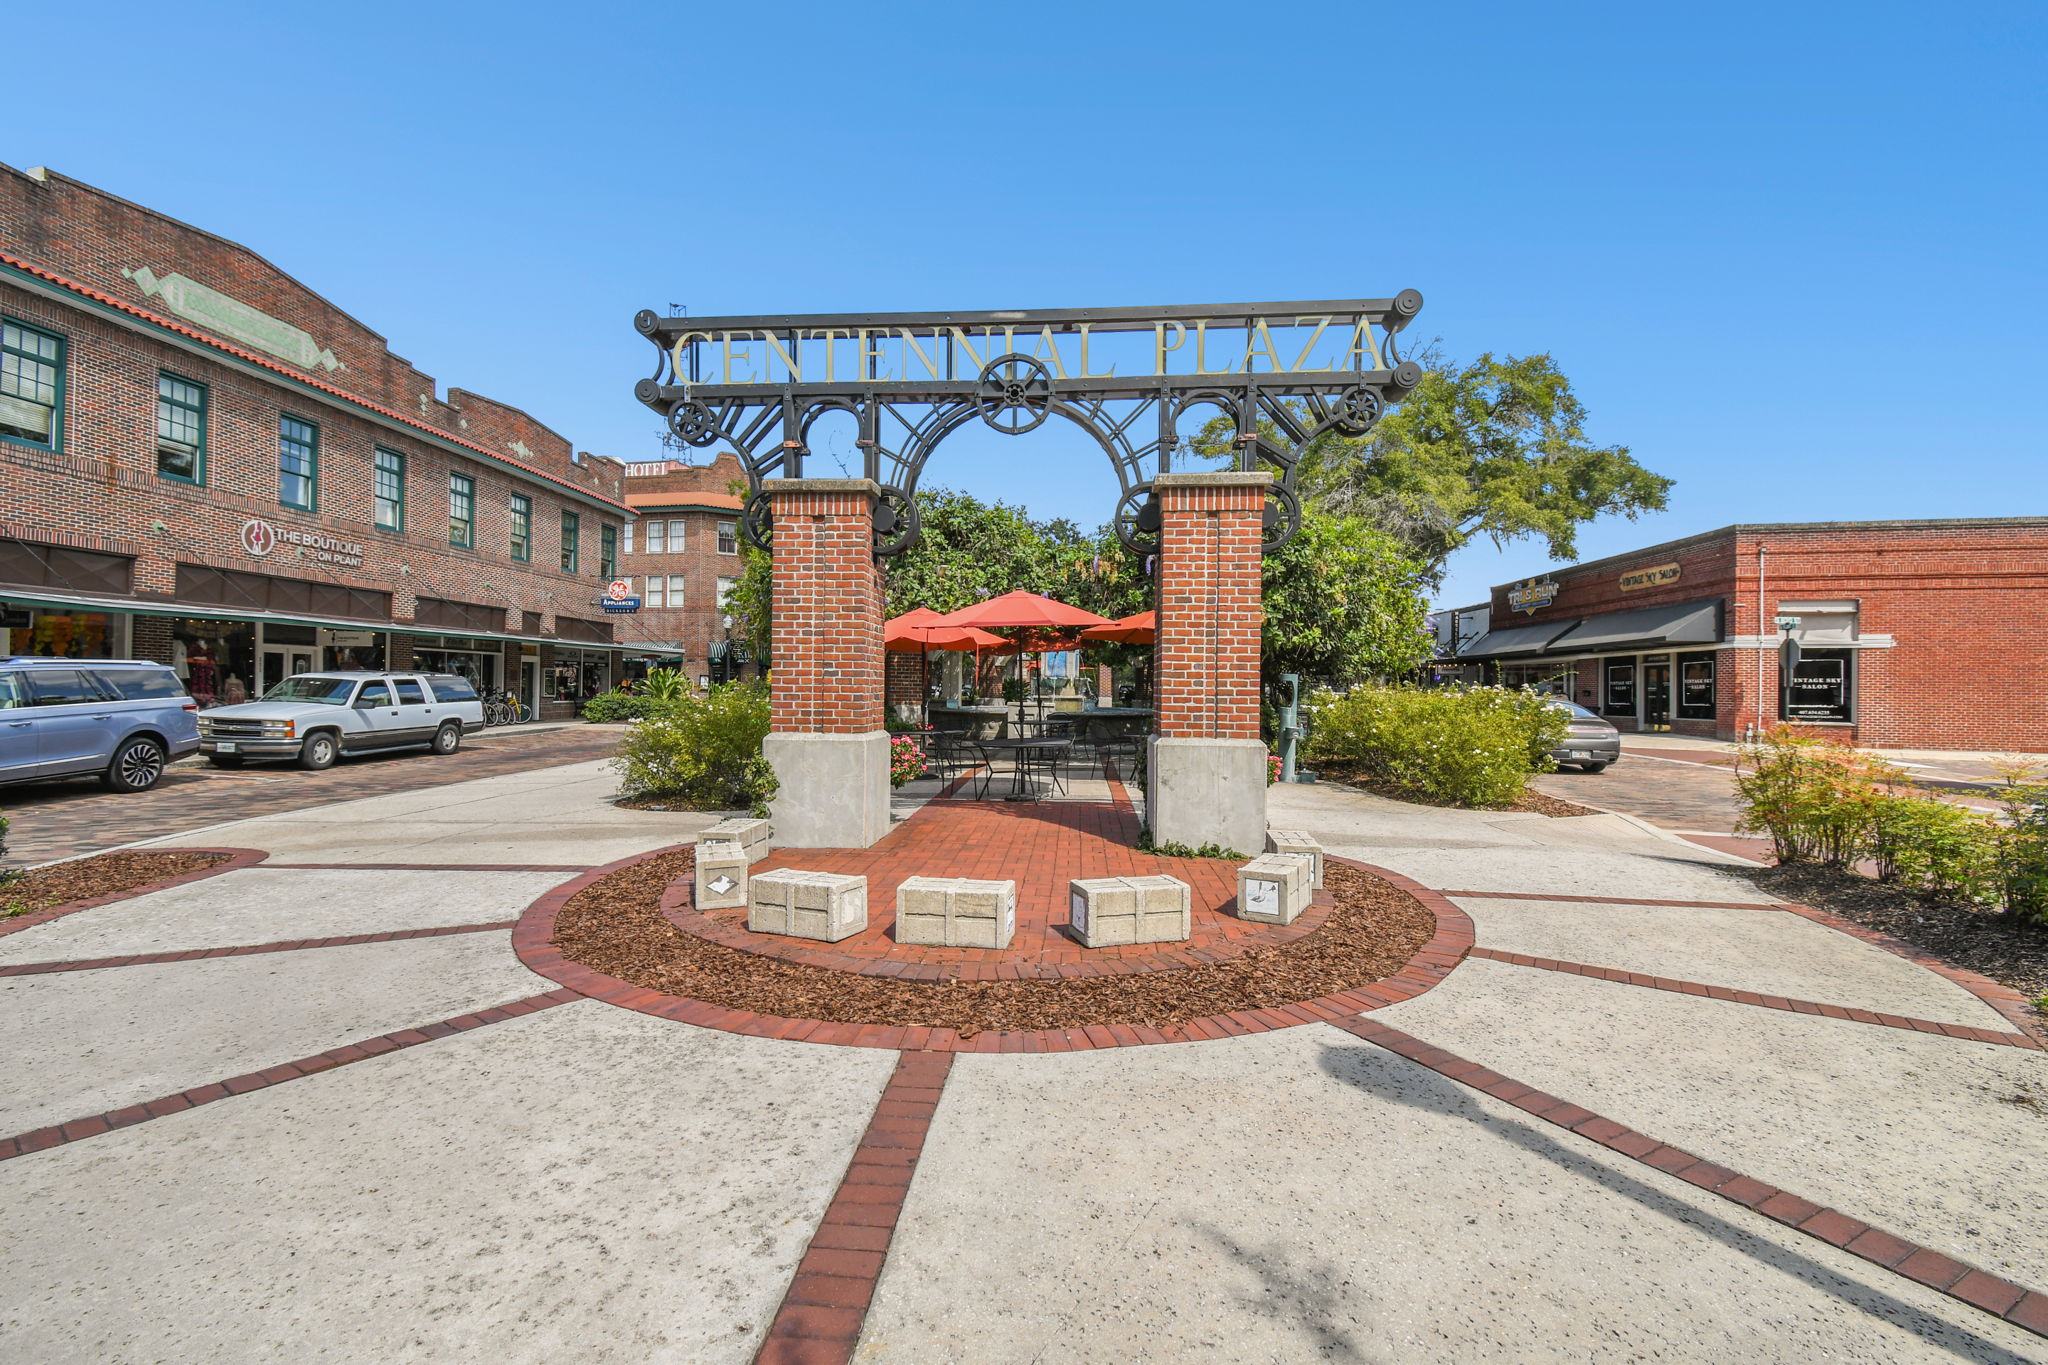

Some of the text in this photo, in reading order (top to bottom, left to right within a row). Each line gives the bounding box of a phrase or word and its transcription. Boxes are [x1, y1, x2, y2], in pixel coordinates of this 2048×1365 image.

[671, 313, 1391, 387] CENTENNIAL PLAZA
[276, 528, 363, 556] THE BOUTIQUE
[318, 551, 363, 567] ON PLANT
[1622, 567, 1678, 586] VINTAGE SKY SALON
